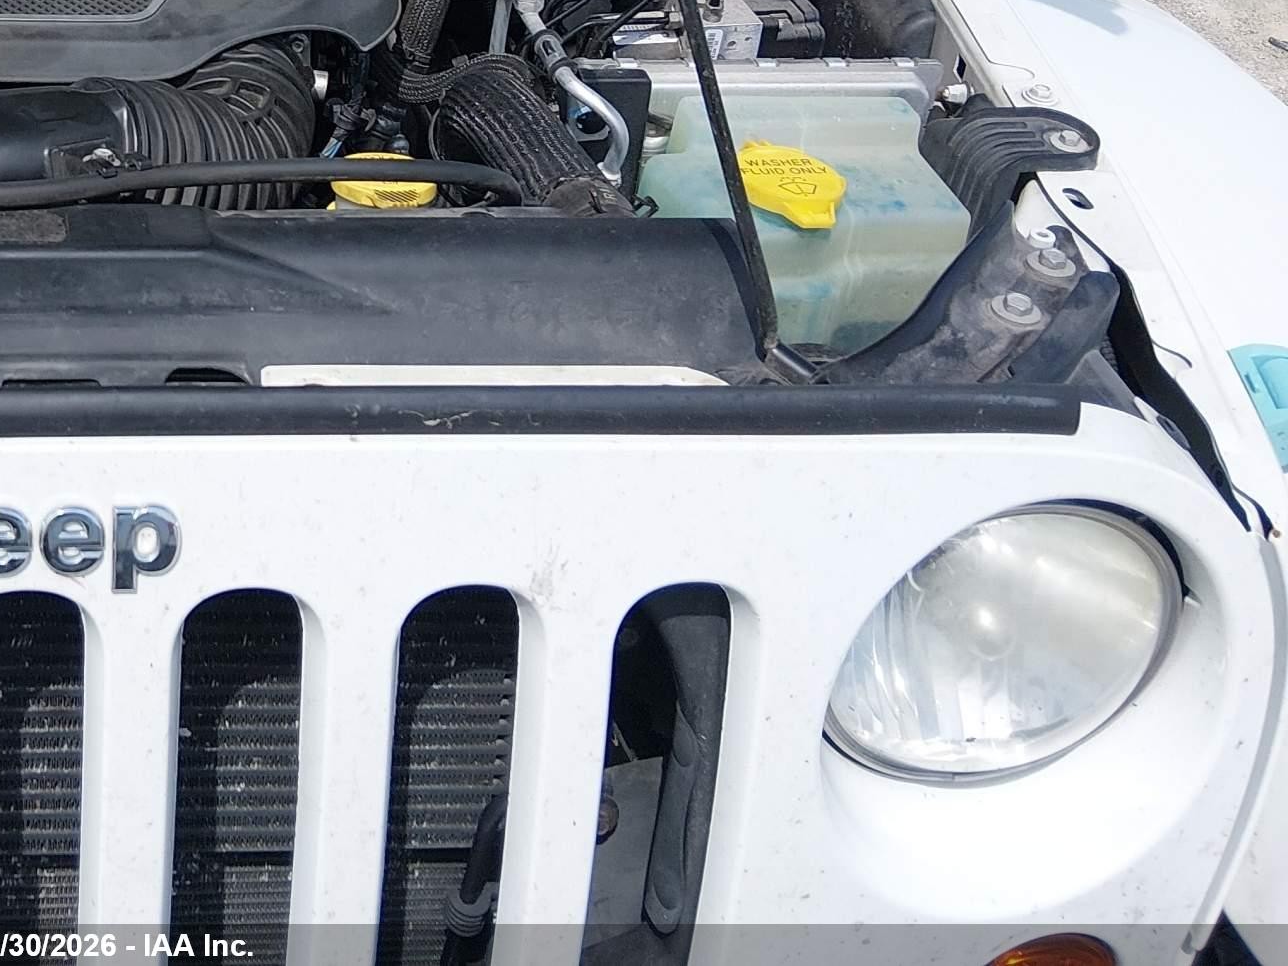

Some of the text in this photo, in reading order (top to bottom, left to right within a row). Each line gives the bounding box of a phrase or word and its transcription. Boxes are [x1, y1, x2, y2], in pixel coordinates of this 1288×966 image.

[745, 158, 813, 167] WASHER
[741, 166, 828, 176] FLUID ONLY
